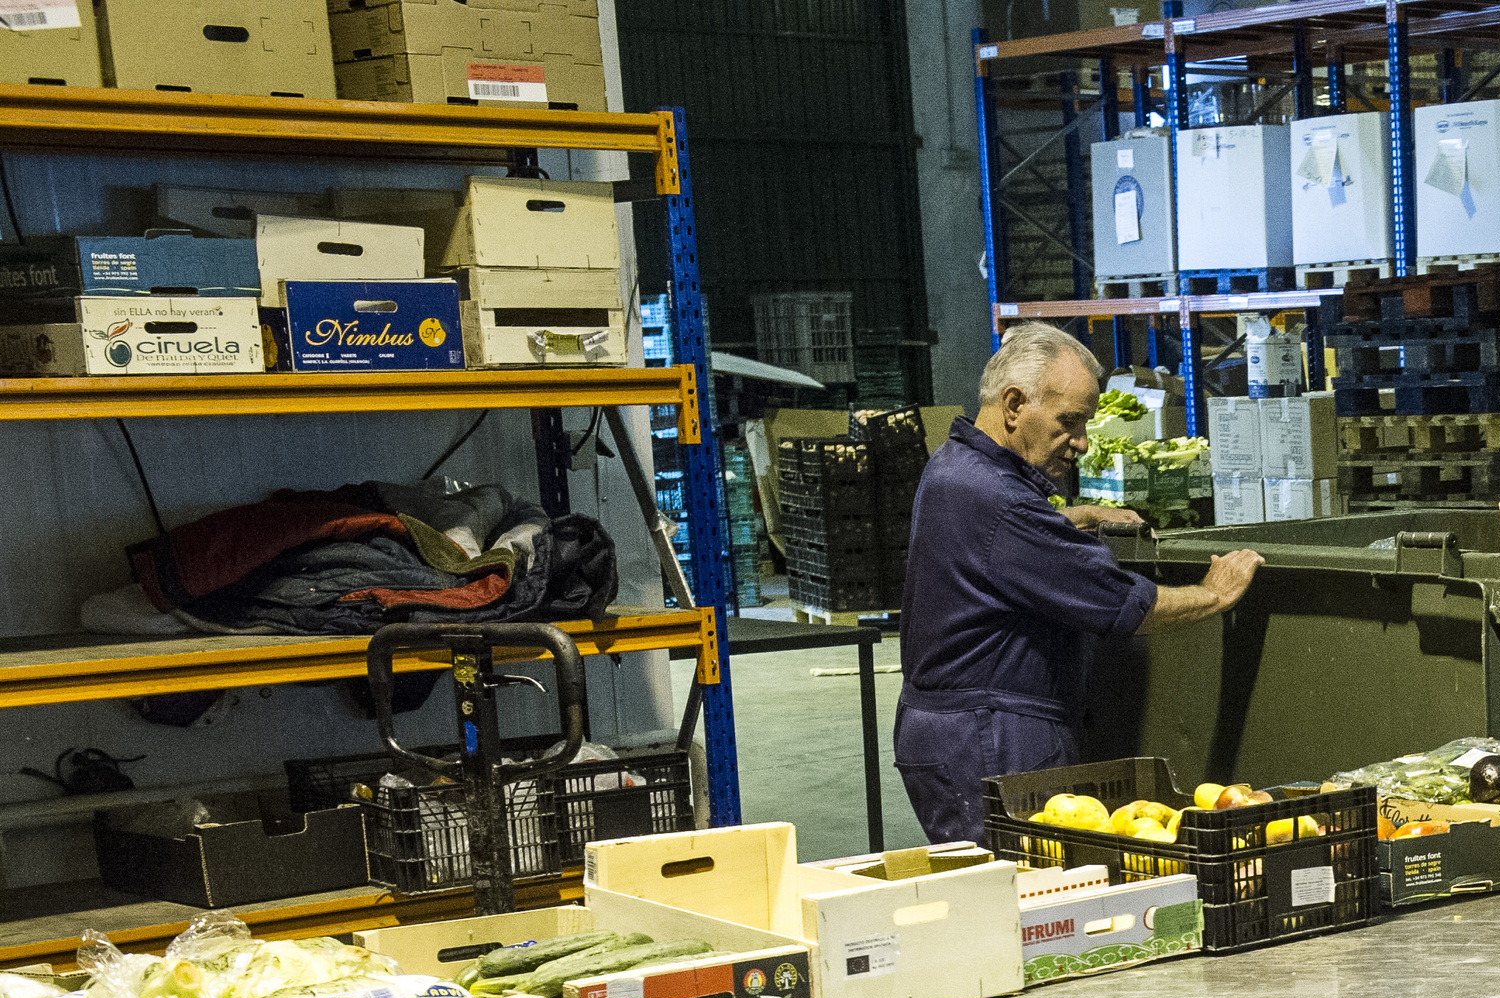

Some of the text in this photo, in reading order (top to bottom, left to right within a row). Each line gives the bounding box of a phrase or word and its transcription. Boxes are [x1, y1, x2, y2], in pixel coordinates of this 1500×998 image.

[113, 308, 126, 316] sin
[129, 308, 152, 316] ELLA
[170, 307, 187, 317] hay
[305, 318, 414, 346] Nimbus
[136, 336, 240, 354] ciruela
[1427, 852, 1441, 860] font
